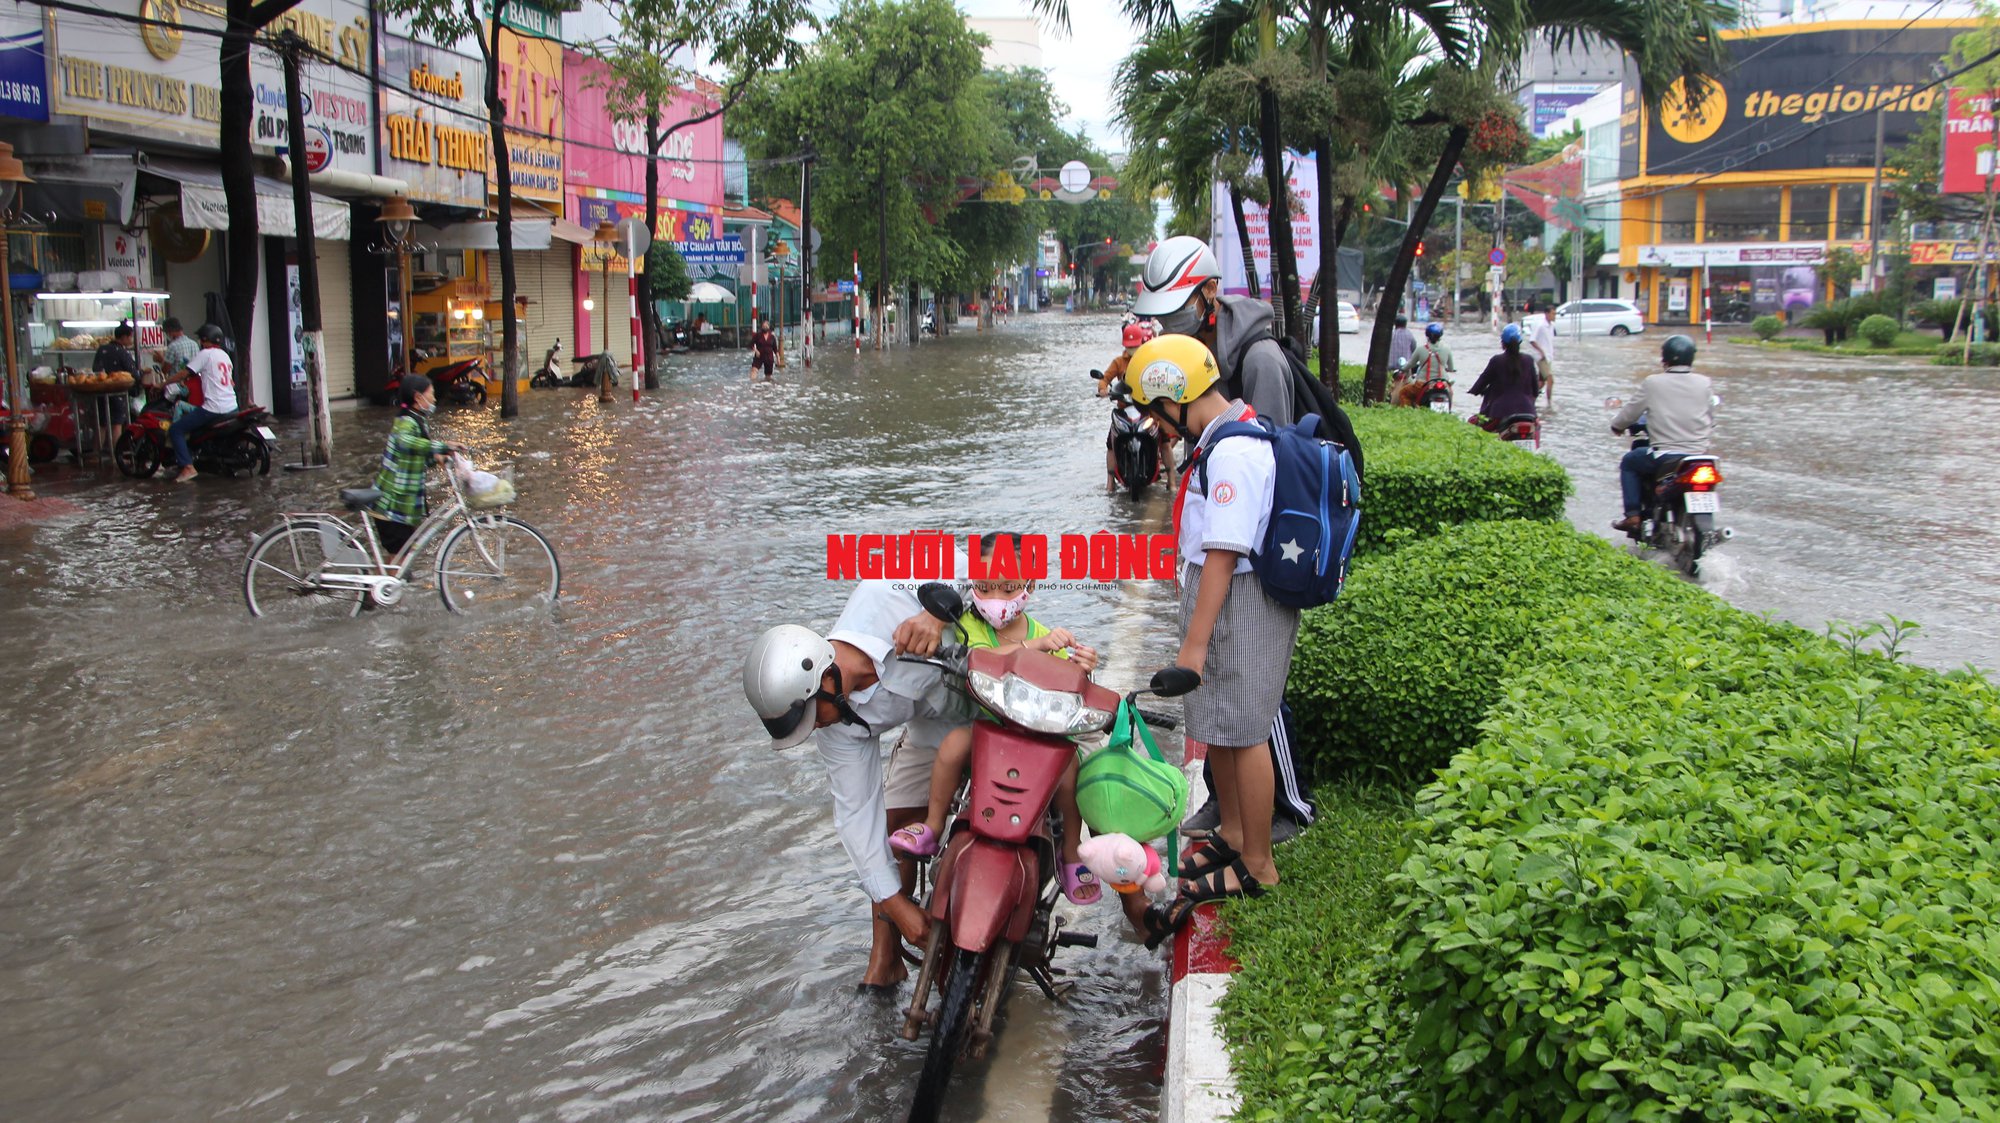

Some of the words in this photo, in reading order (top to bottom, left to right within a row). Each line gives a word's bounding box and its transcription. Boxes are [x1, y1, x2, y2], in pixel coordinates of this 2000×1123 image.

[12, 81, 21, 102] 68
[21, 83, 31, 104] 66
[31, 85, 40, 105] 79
[62, 57, 103, 99] THE
[105, 65, 187, 115] PRINCESS
[1744, 84, 1944, 123] thegioidid
[312, 88, 367, 126] VESTON
[387, 107, 433, 165] THÁI
[435, 124, 487, 181] THỊNH
[141, 326, 164, 346] ANH
